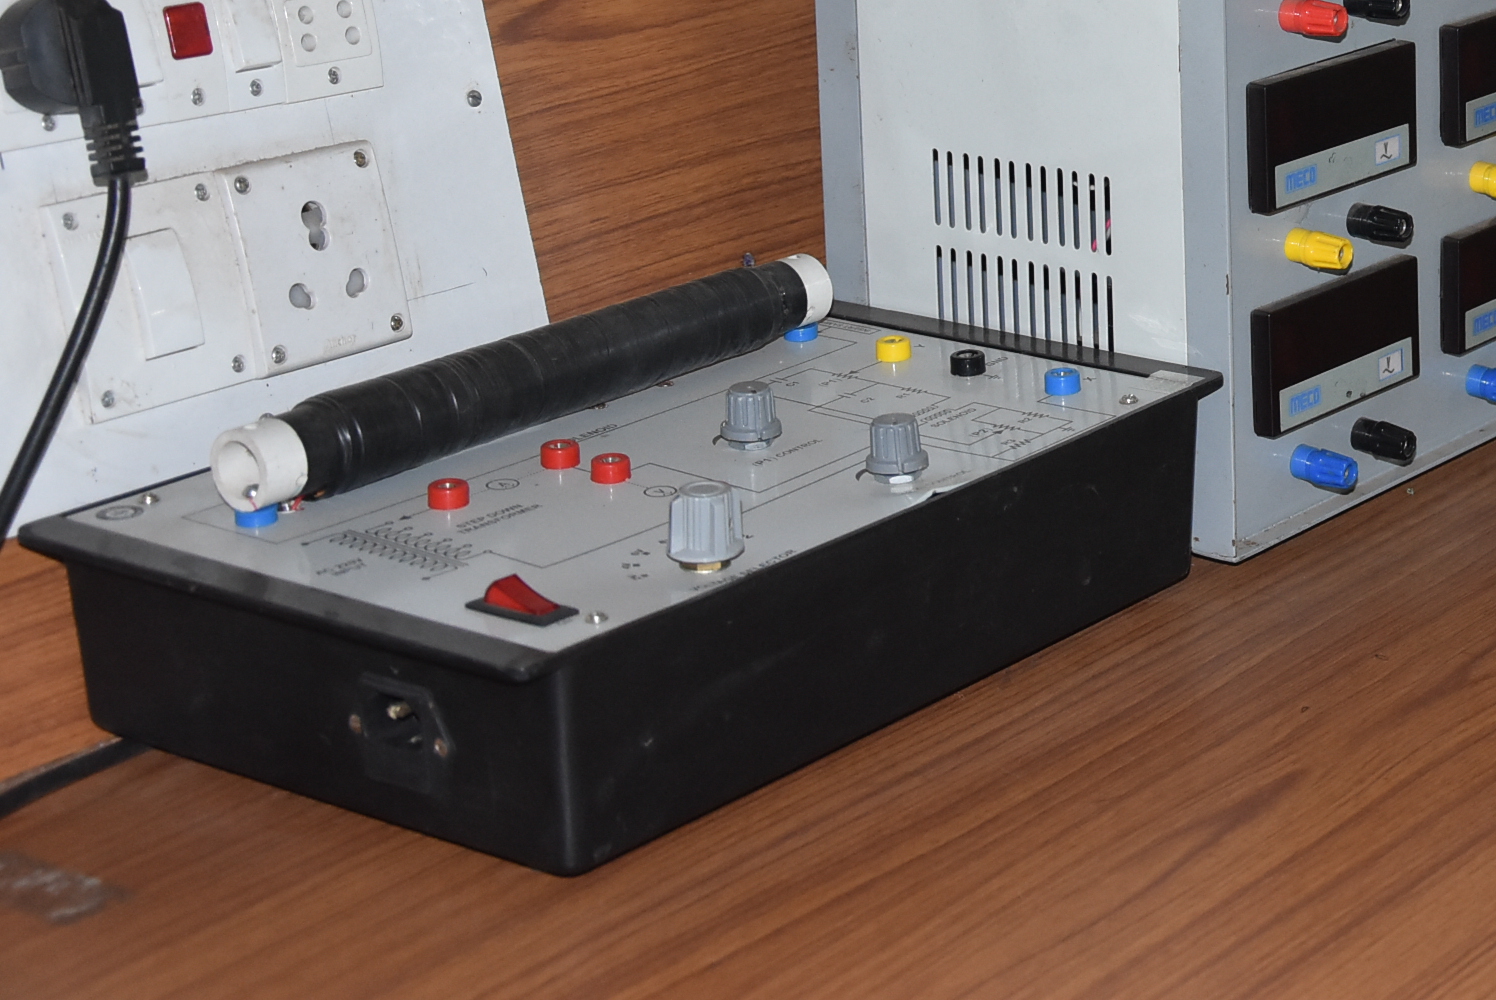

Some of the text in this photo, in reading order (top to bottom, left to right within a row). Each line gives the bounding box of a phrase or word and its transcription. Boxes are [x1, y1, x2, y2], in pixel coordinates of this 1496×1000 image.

[1285, 164, 1317, 194] MECO
[1289, 385, 1321, 417] MECO
[930, 408, 977, 428] SOLENOID
[571, 422, 619, 441] LENOID
[774, 438, 823, 459] CONTROL
[457, 503, 543, 534] TRANSFORMER
[486, 503, 523, 518] DOWN
